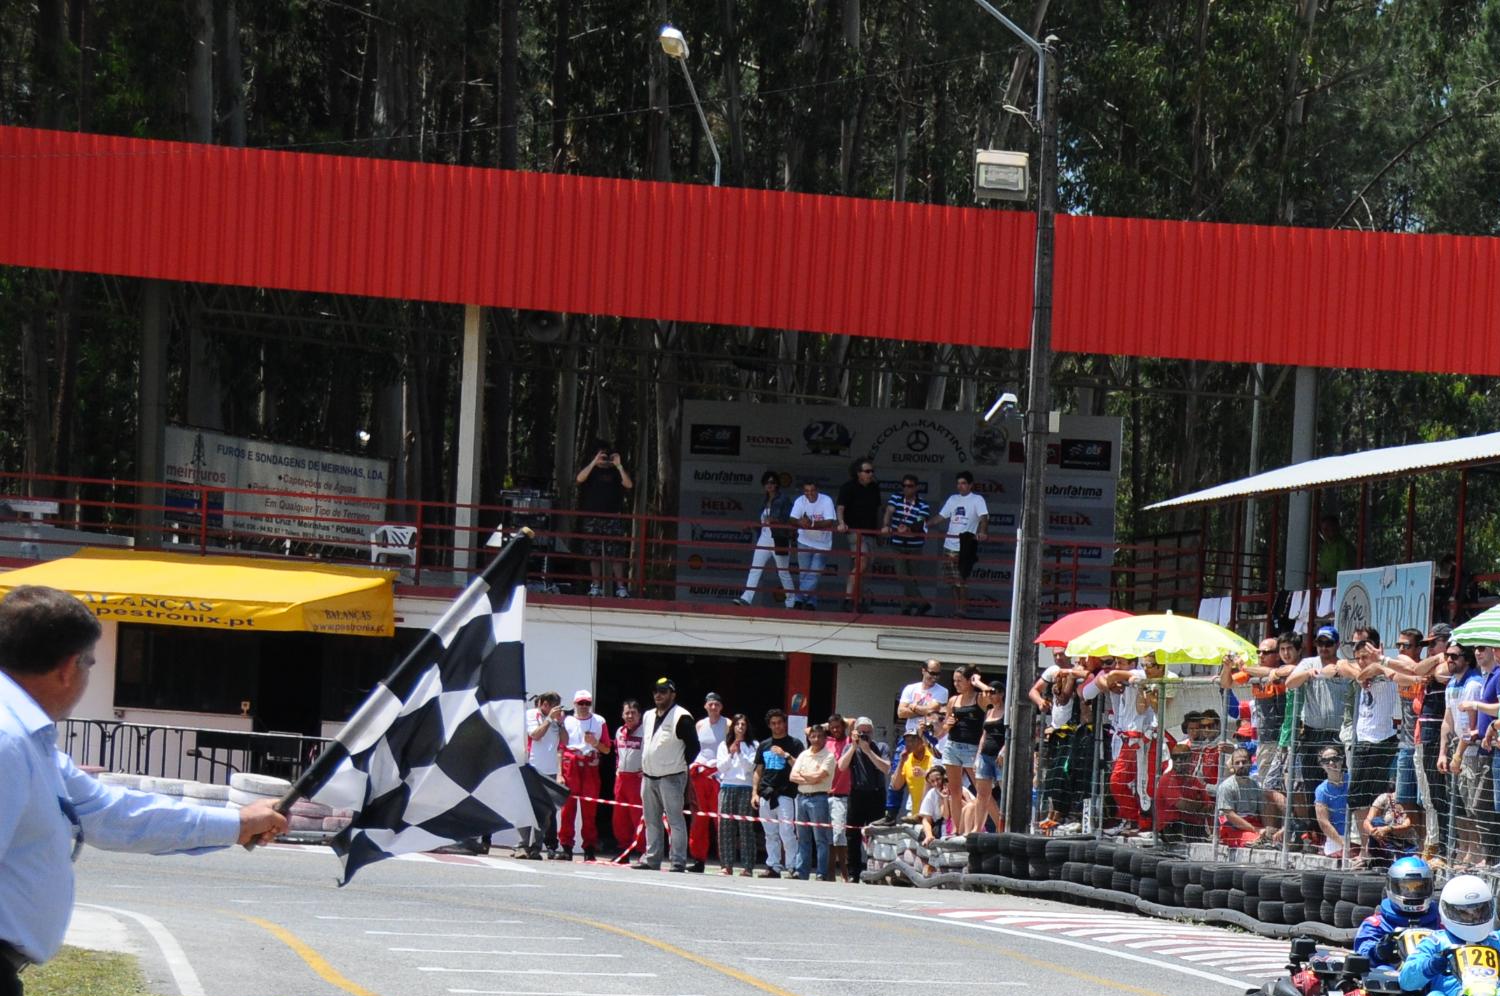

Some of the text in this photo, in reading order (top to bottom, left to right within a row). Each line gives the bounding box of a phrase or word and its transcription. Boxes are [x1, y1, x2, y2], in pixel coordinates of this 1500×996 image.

[809, 422, 839, 441] 24
[746, 435, 793, 445] HONDA
[868, 420, 909, 460] ESCOLA
[918, 419, 967, 463] KARTING
[217, 444, 246, 460] FUROS
[247, 450, 254, 461] E
[255, 452, 306, 469] SONDAGENS
[307, 458, 320, 471] DE
[892, 453, 945, 463] EUROINDY
[971, 482, 1005, 494] ELIX
[1045, 483, 1103, 497] ubrifatima
[701, 497, 743, 511] HELIX
[1049, 514, 1092, 526] HELIX
[83, 592, 214, 612] ALANÇAS
[96, 607, 256, 627] pestronix.pt
[1458, 948, 1497, 969] 128
